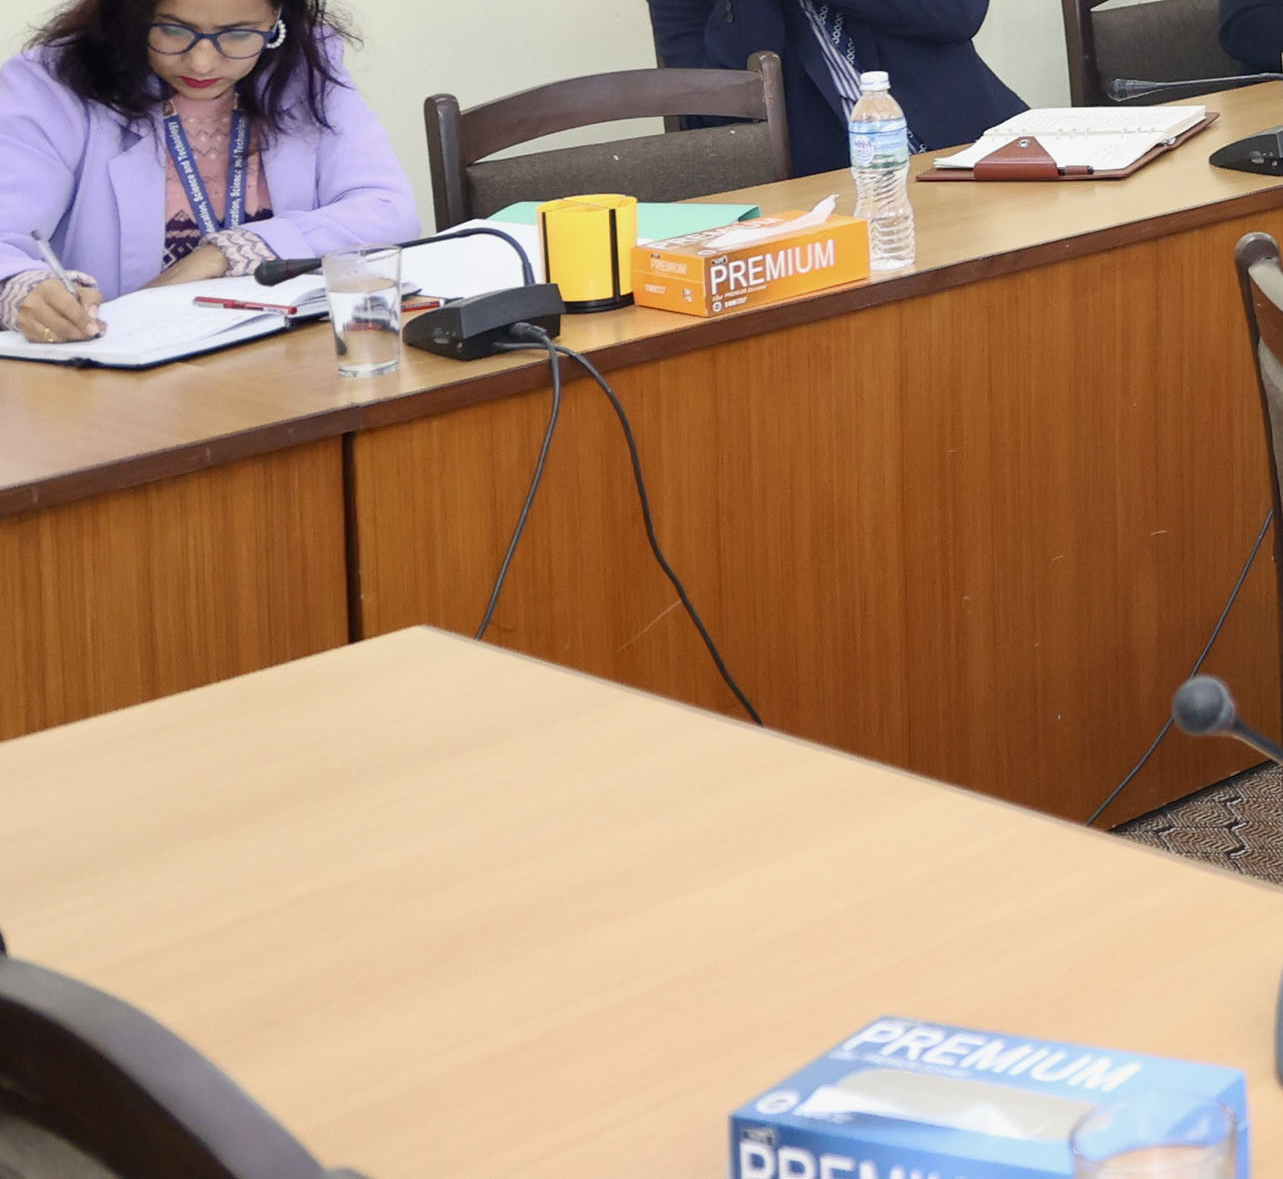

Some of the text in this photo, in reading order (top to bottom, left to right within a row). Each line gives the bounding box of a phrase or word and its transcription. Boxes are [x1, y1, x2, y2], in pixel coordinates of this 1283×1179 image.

[168, 121, 216, 233] ducation, Science and Technology
[230, 170, 242, 197] Science
[229, 198, 242, 229] ucation,
[650, 259, 687, 275] PREMIUM
[710, 239, 835, 295] PREMIUM
[842, 1019, 1142, 1092] PREMIUM
